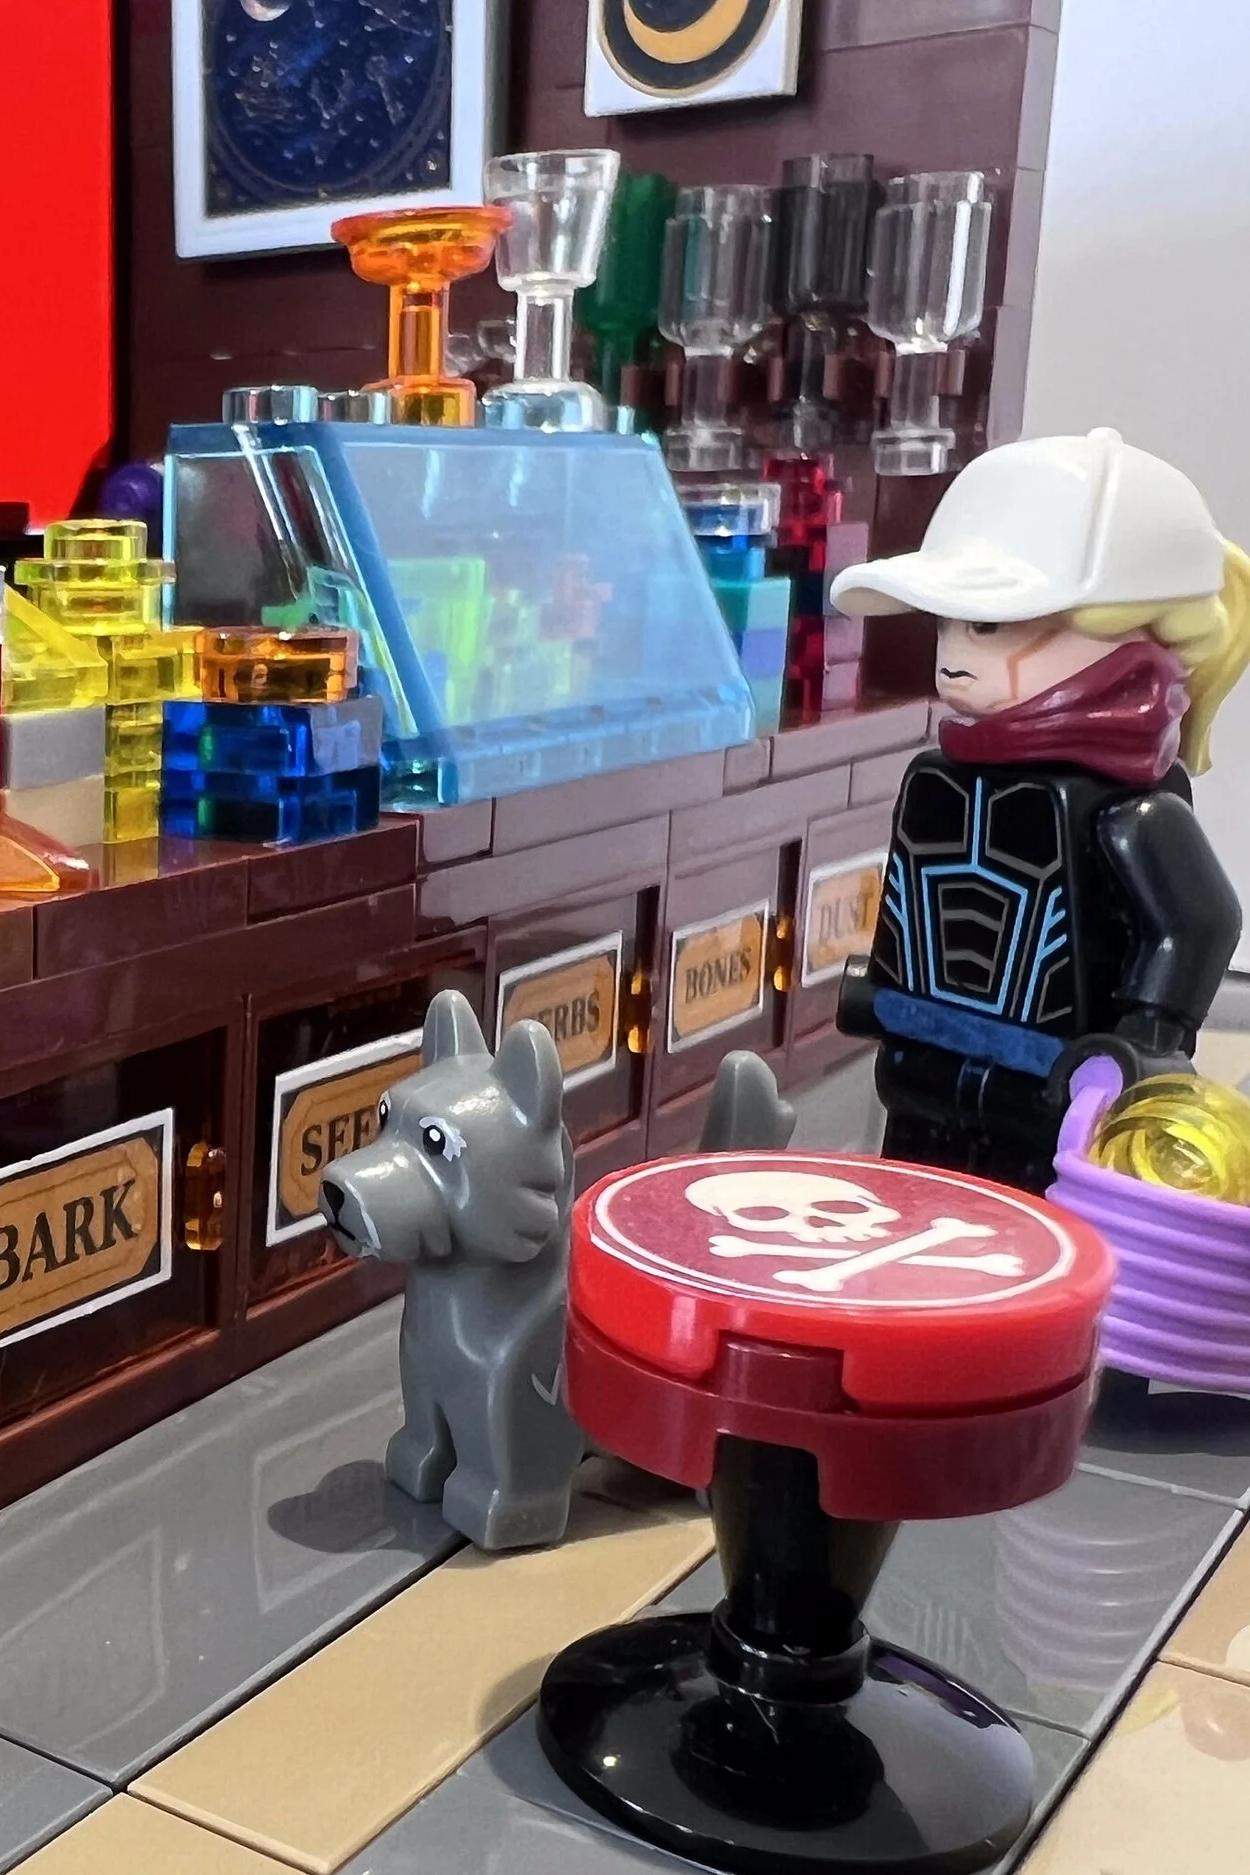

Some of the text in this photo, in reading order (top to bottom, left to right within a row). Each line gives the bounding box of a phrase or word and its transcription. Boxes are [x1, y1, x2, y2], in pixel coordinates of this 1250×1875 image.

[818, 891, 875, 946] DUST
[685, 946, 752, 1005] BONES
[535, 987, 600, 1042] RBS
[301, 1104, 376, 1176] SEE
